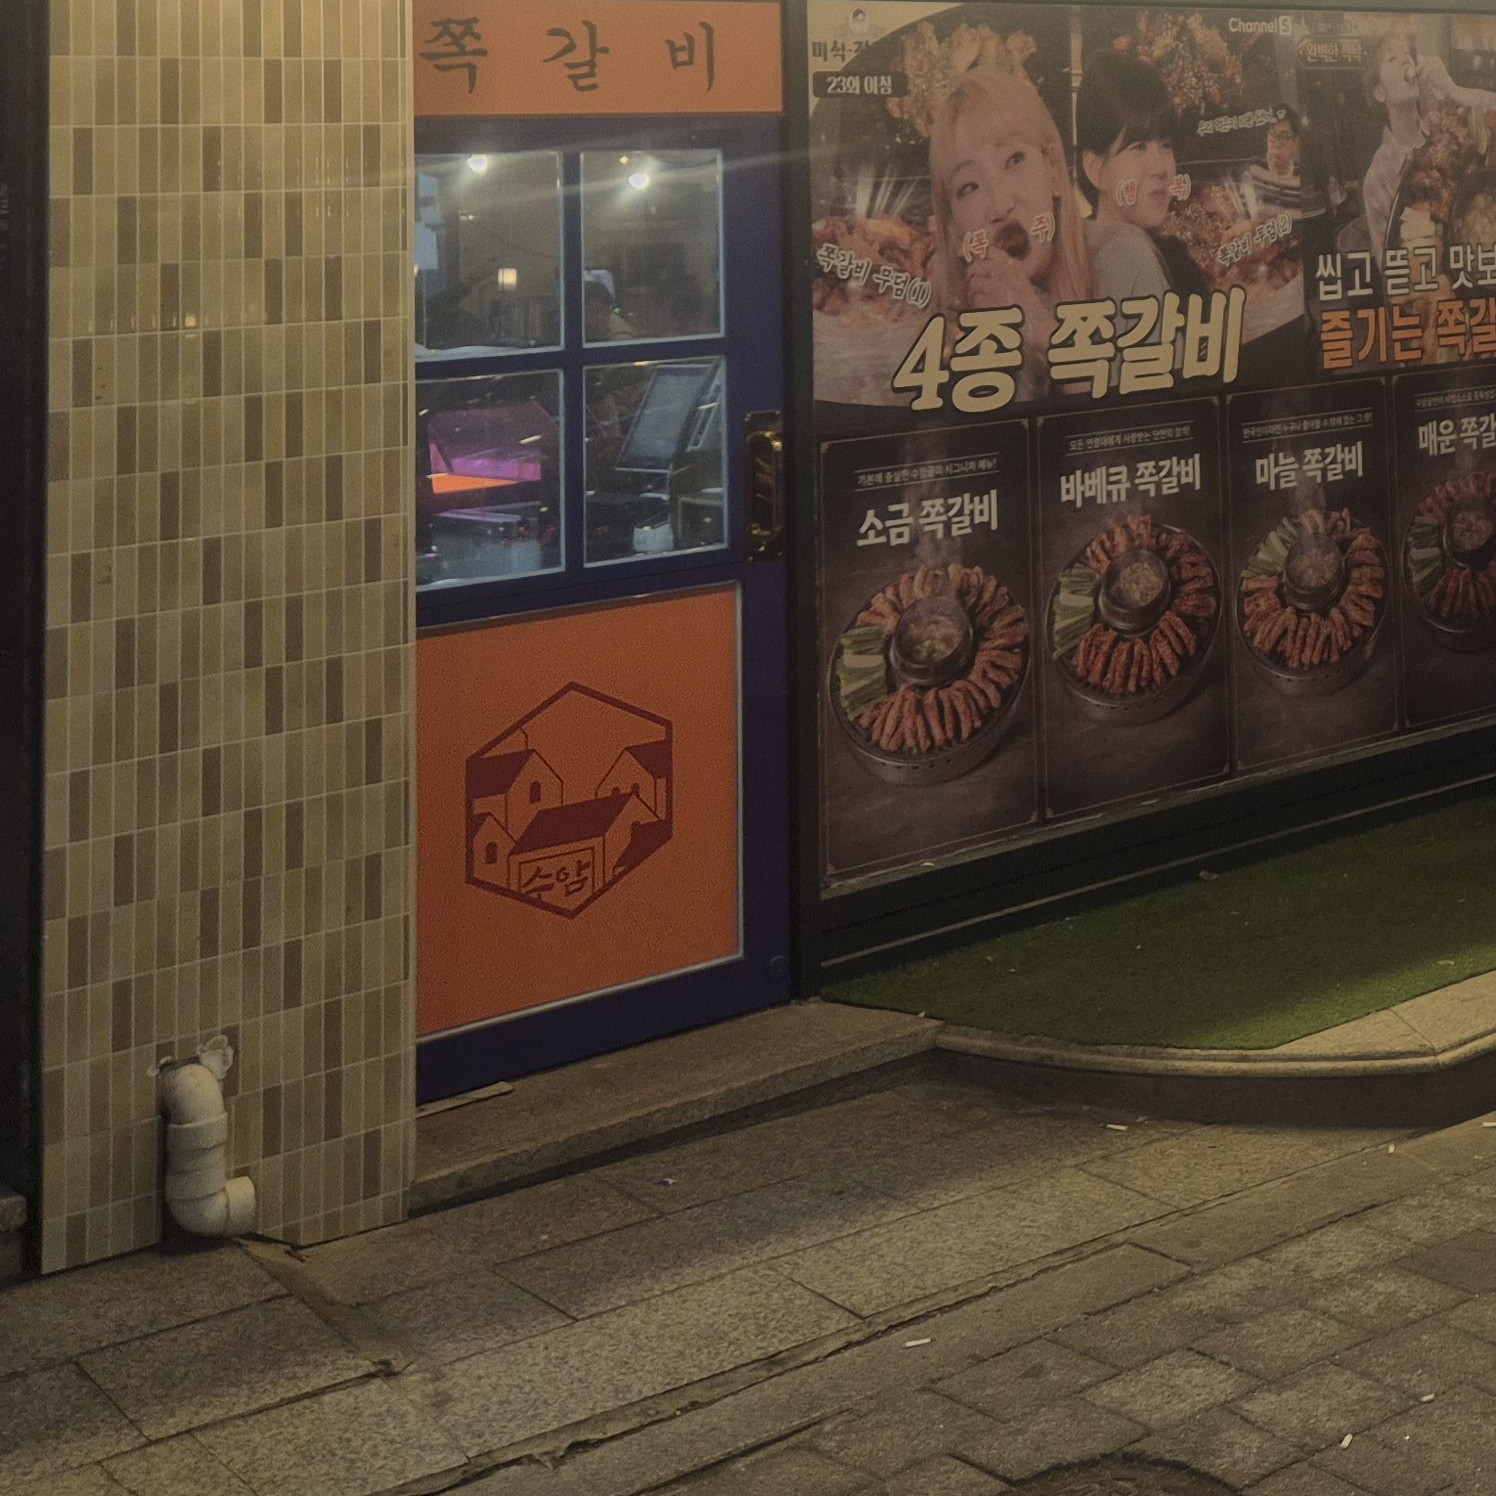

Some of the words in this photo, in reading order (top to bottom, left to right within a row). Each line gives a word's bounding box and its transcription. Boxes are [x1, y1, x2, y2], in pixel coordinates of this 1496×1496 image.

[418, 16, 718, 94] 쪽갈비
[816, 243, 872, 286] 쪽갈비
[1316, 250, 1374, 301] 씹고
[1384, 244, 1439, 296] 뜯고
[892, 306, 1024, 414] 4종
[1047, 284, 1248, 400] 쪽갈비
[1320, 303, 1424, 370] 즐기는
[1418, 417, 1458, 457] 매운
[1060, 465, 1131, 509] 바베큐
[1135, 453, 1202, 501] 쪽갈비
[1255, 451, 1298, 491] 마늘
[1302, 441, 1363, 487] 쪽갈비
[857, 501, 912, 547] 소금
[918, 489, 999, 539] 쪽갈비
